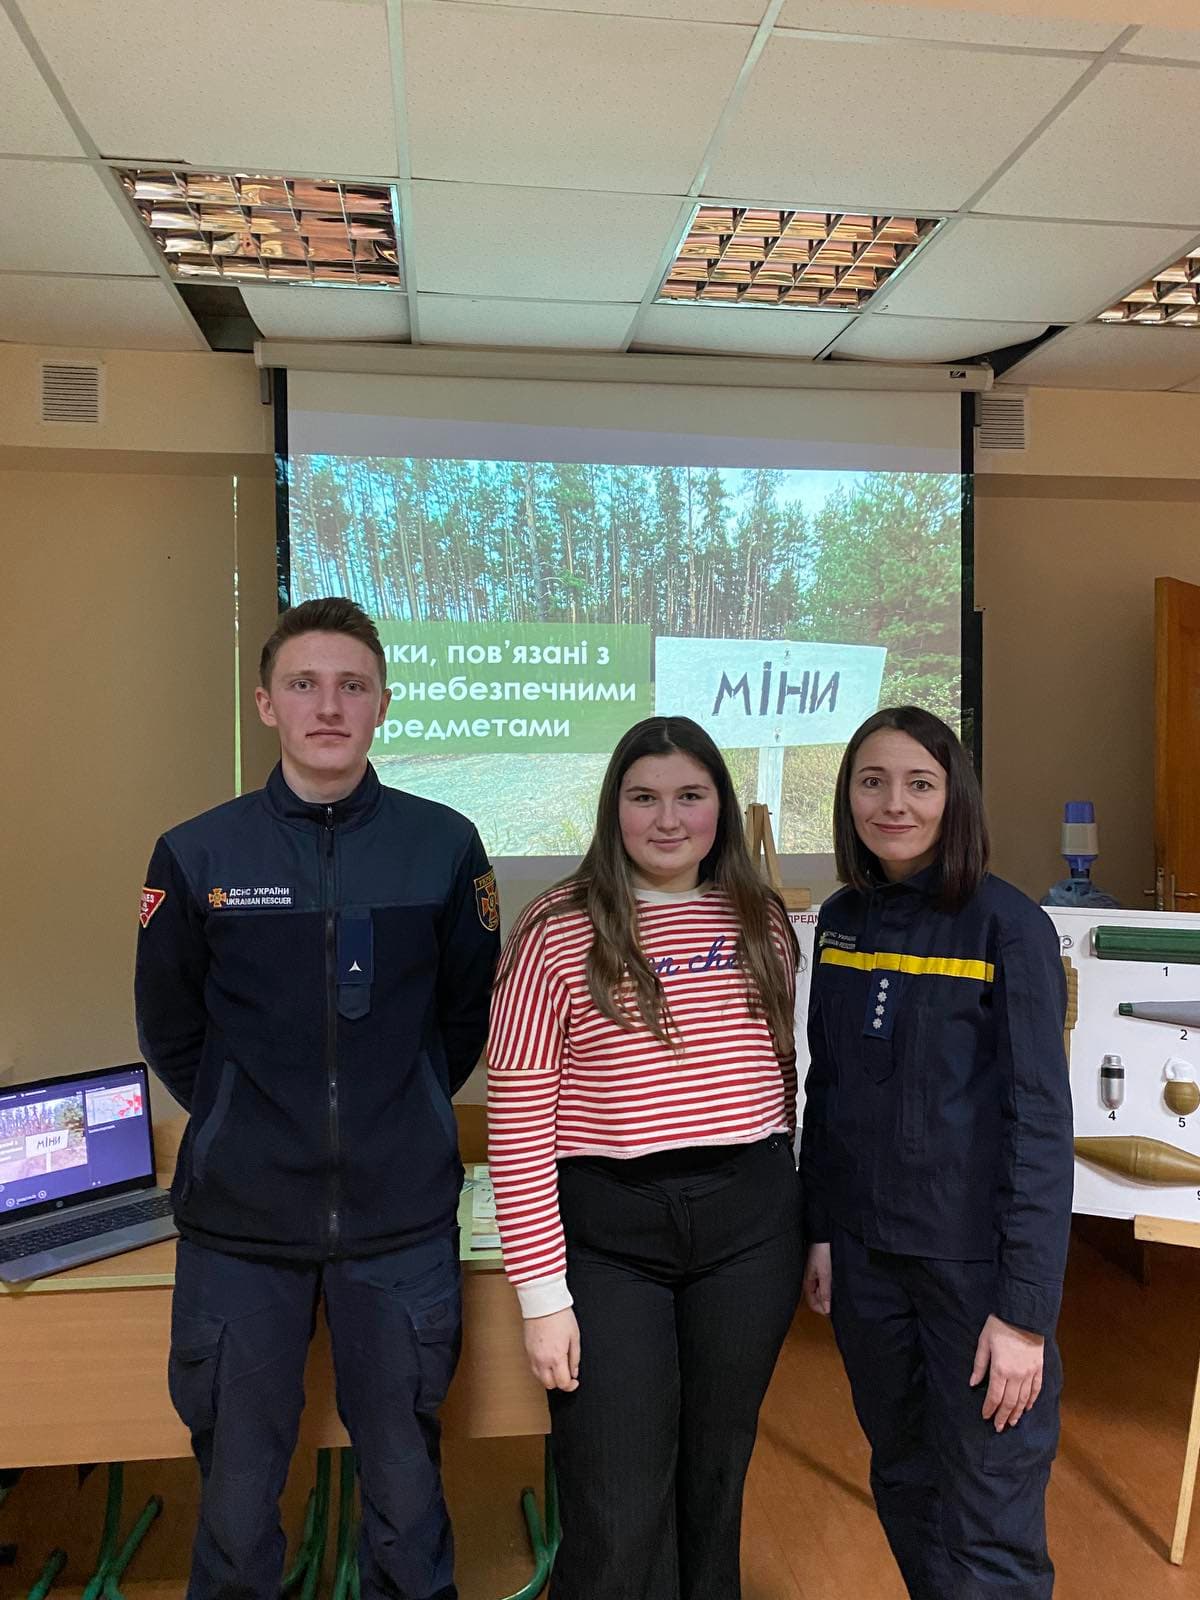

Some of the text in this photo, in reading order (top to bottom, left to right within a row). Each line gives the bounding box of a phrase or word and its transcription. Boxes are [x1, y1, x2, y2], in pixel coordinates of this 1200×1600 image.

[596, 644, 610, 666] з
[253, 886, 290, 896] УКРАЇНИ
[261, 896, 292, 905] RESCUER
[1163, 966, 1169, 977] 1
[1179, 1029, 1188, 1041] 2
[1108, 1110, 1117, 1121] 4
[1178, 1117, 1186, 1128] 5
